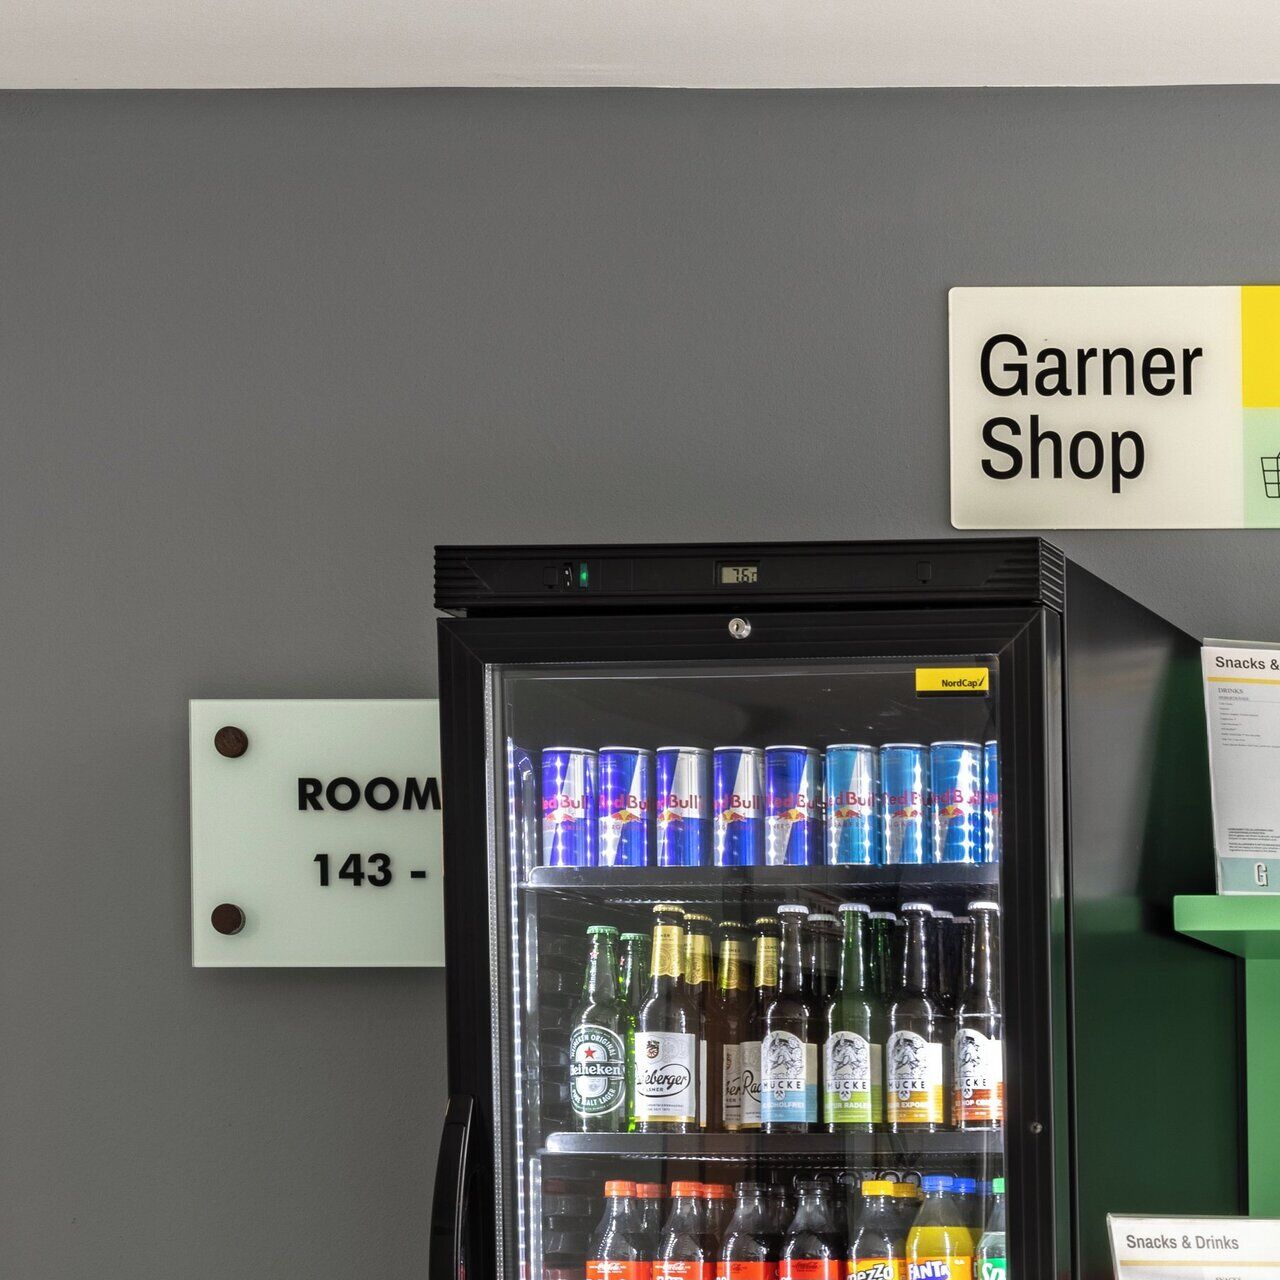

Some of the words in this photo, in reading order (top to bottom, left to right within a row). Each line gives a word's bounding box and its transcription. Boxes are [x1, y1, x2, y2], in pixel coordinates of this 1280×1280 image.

[981, 334, 1203, 396] Garner
[981, 414, 1145, 493] Shop
[1215, 656, 1266, 670] Snacks
[1270, 659, 1280, 671] &
[941, 679, 978, 689] NordCap
[298, 776, 441, 811] ROOM
[670, 794, 698, 809] Bull
[731, 794, 760, 809] Bull
[313, 853, 392, 887] 143
[591, 1034, 616, 1057] ORIGINAL
[637, 1069, 688, 1091] eberger
[599, 1087, 616, 1104] LAGER
[1126, 1234, 1177, 1249] Snacks
[1182, 1235, 1192, 1249] &
[1196, 1235, 1239, 1250] Drinks
[909, 1260, 950, 1280] FANTA
